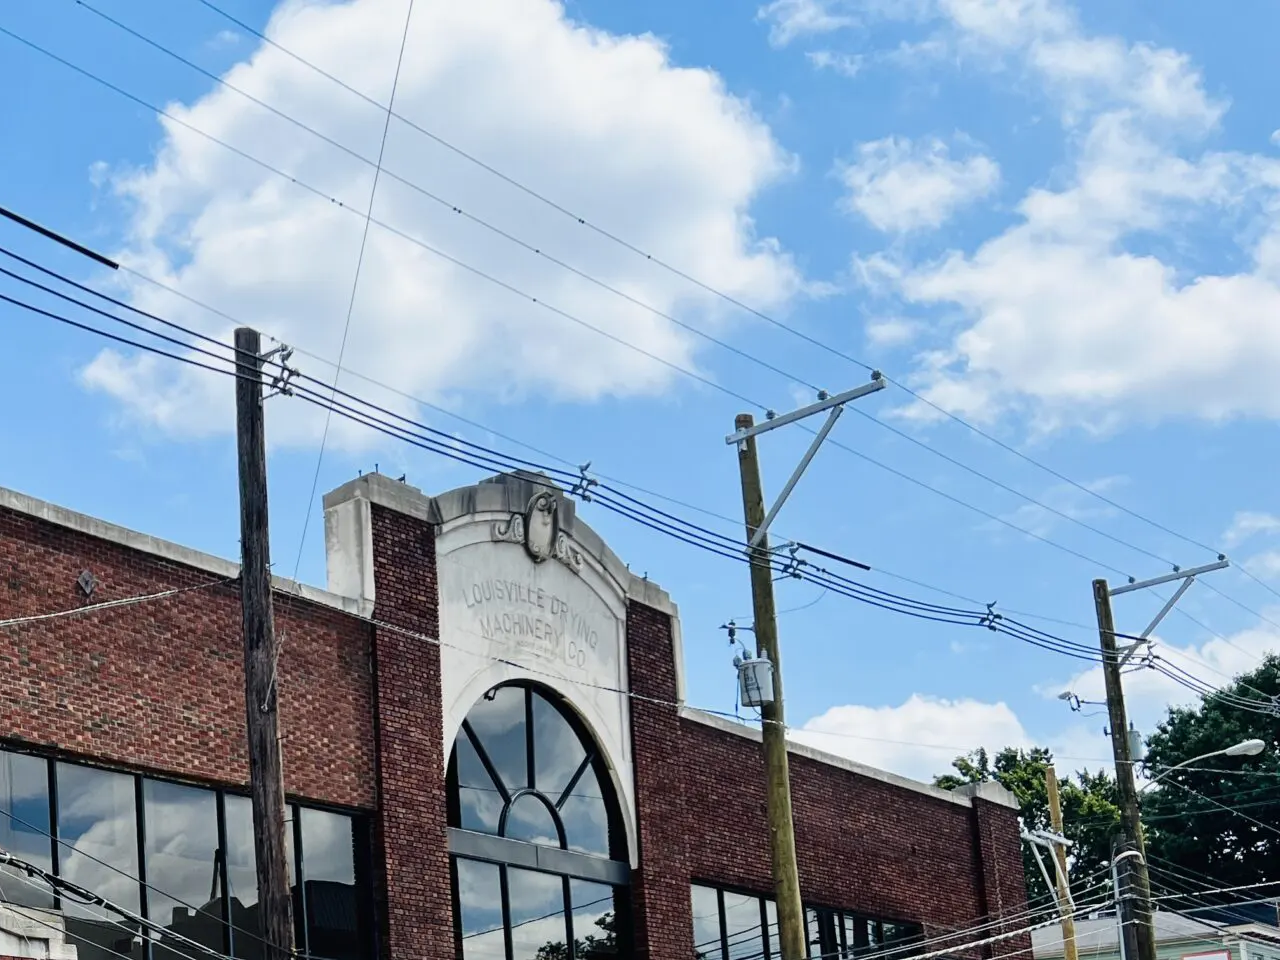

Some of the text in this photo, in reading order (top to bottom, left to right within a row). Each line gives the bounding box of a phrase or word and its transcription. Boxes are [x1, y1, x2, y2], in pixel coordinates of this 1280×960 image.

[462, 579, 546, 609] LOUISVILLE
[551, 595, 599, 650] DRYING
[479, 613, 564, 647] MACHINERY
[568, 641, 586, 668] CO
